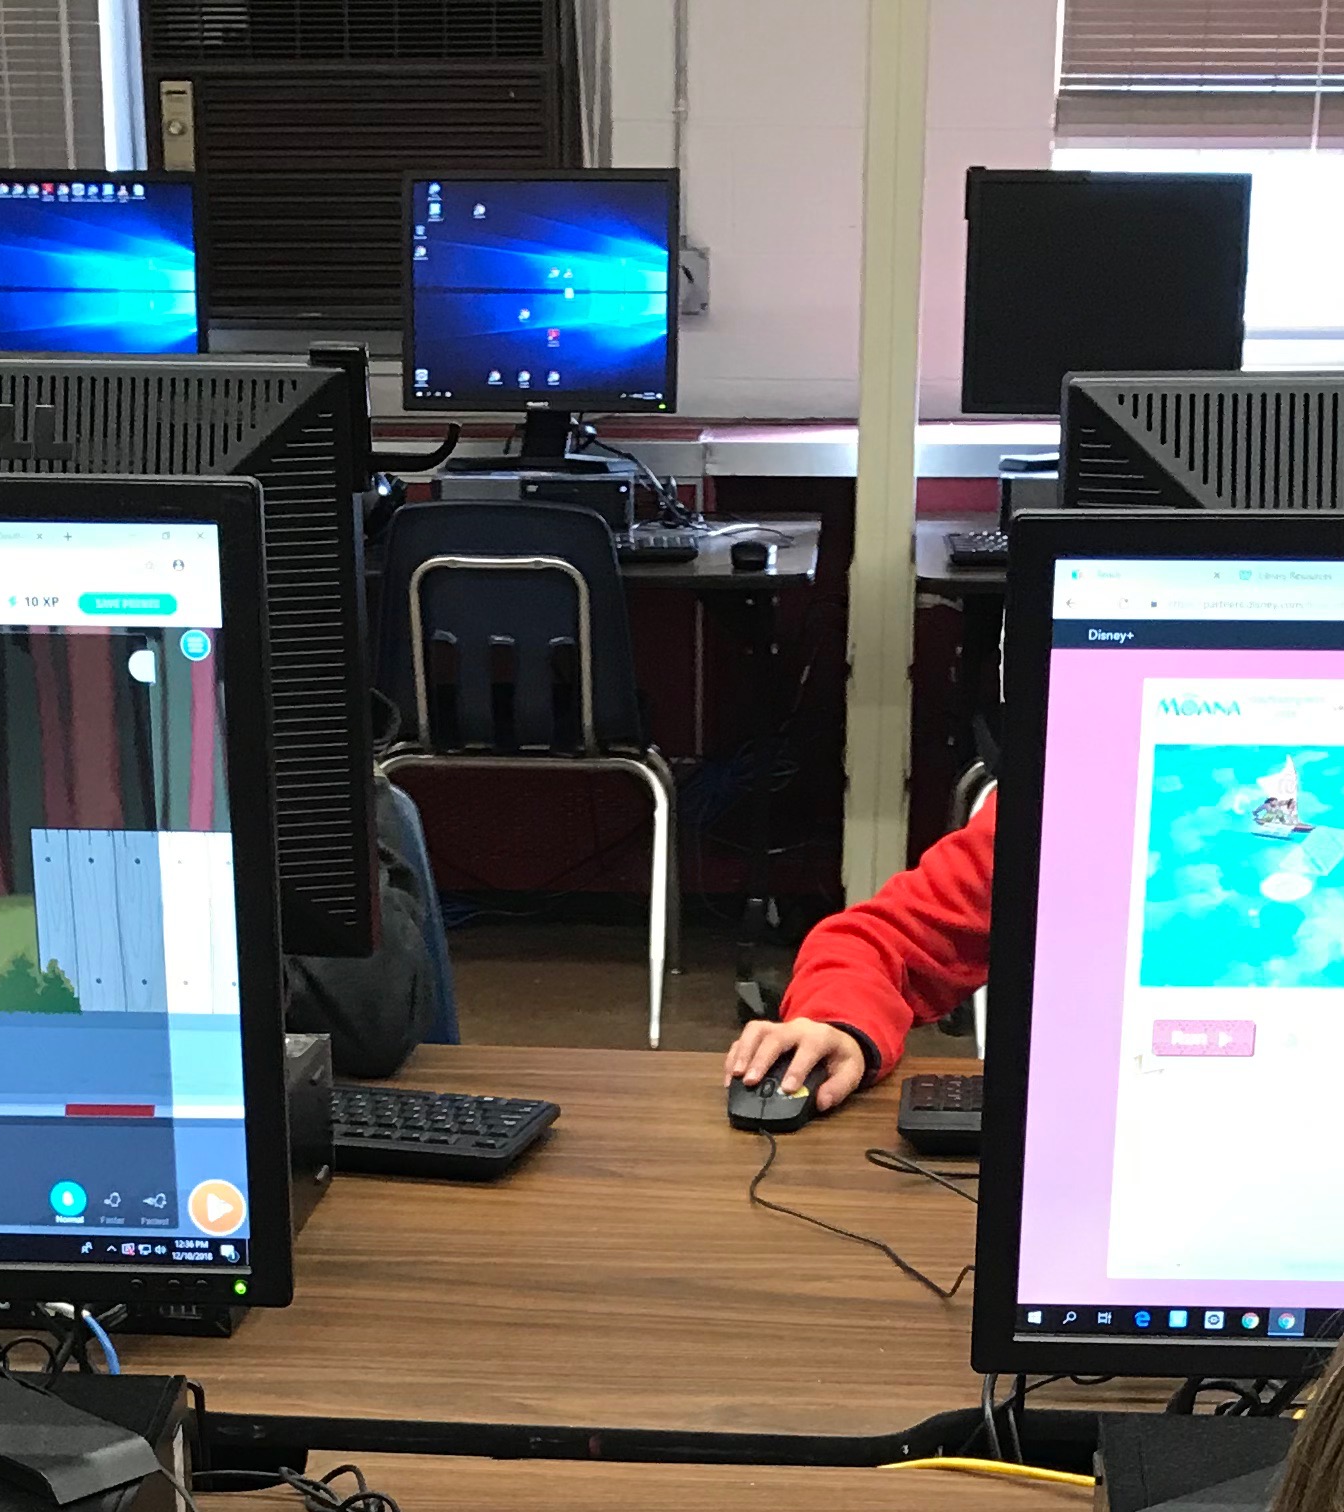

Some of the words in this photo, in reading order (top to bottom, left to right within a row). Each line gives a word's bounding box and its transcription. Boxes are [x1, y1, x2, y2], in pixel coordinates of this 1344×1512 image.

[1258, 571, 1287, 583] Library
[1290, 571, 1333, 582] Resources
[25, 597, 39, 607] 10
[43, 597, 59, 607] XP
[1088, 629, 1135, 643] Disney+
[1157, 694, 1242, 717] MOANA
[174, 1240, 195, 1249] 12:36
[196, 1240, 210, 1249] PM
[171, 1252, 214, 1261] 12/10/2018
